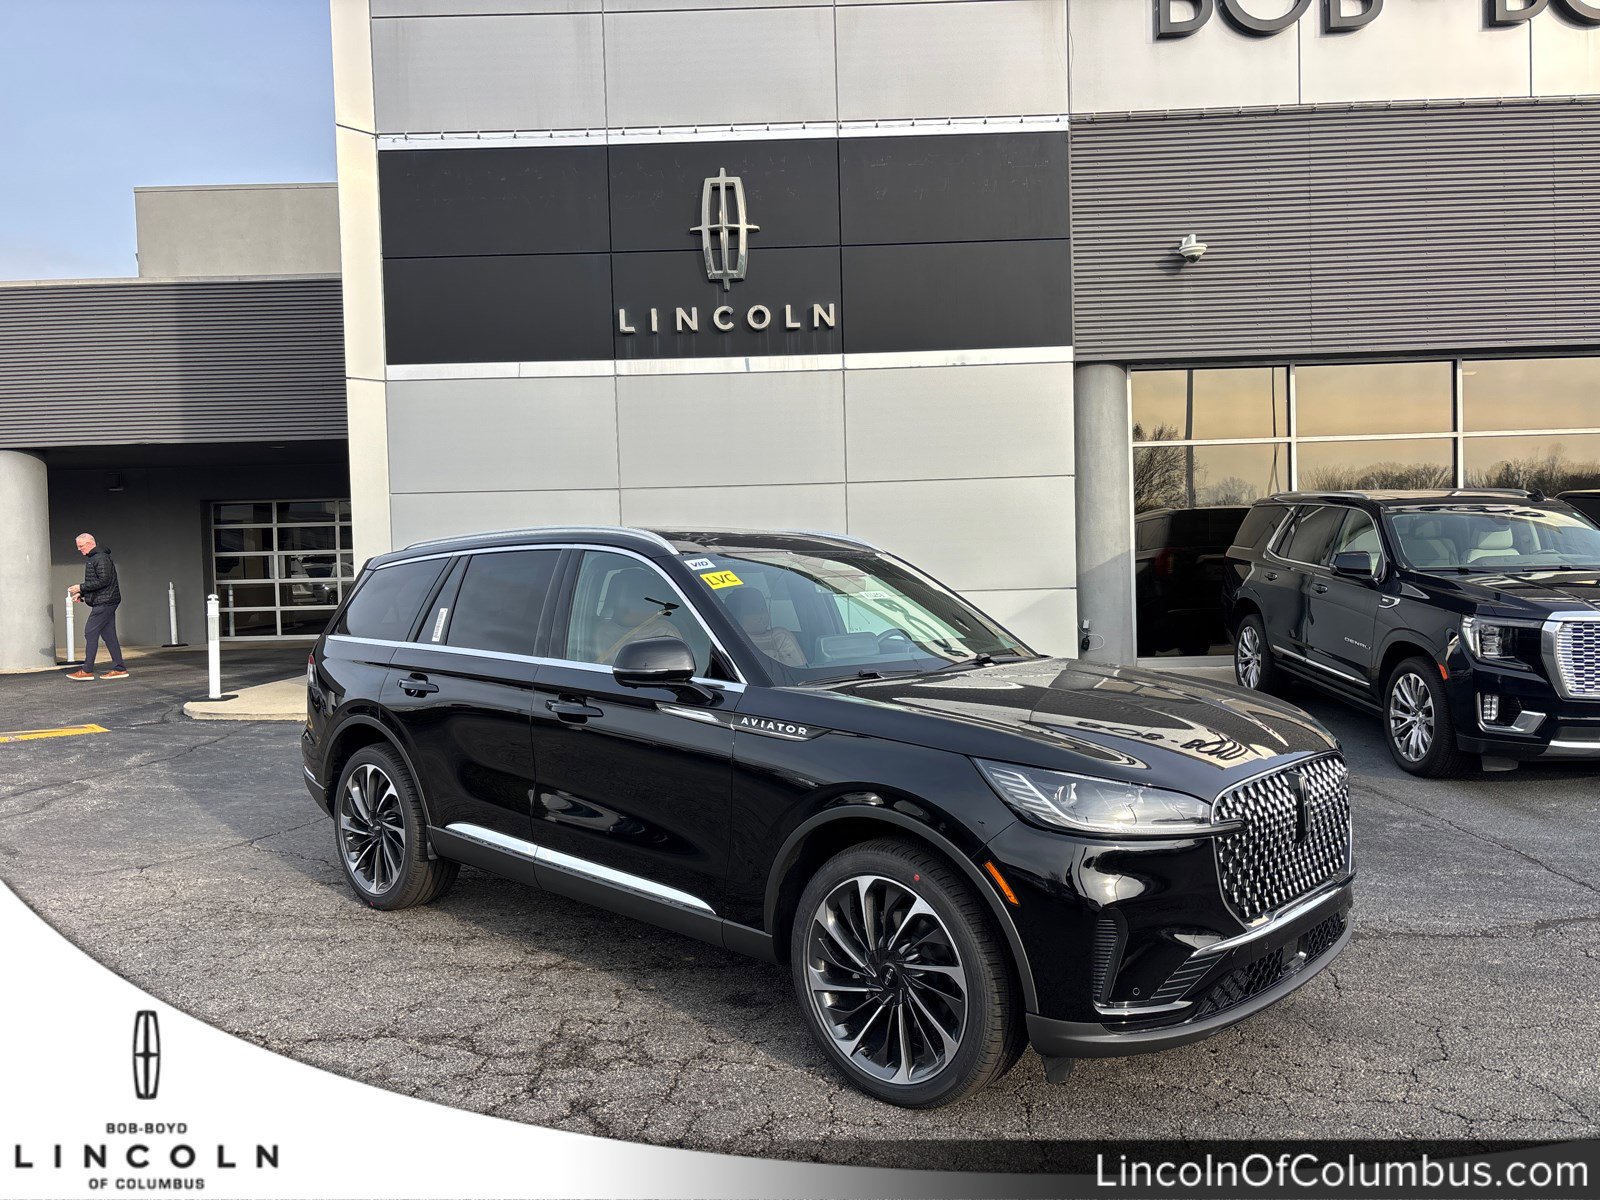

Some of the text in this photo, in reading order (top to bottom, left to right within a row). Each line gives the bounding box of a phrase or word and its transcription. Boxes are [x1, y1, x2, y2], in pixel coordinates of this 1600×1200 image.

[618, 303, 836, 334] LINCOLN
[690, 560, 709, 568] VID
[706, 573, 738, 586] LVC
[1344, 636, 1371, 651] DENALI
[740, 716, 807, 736] AVIATOR
